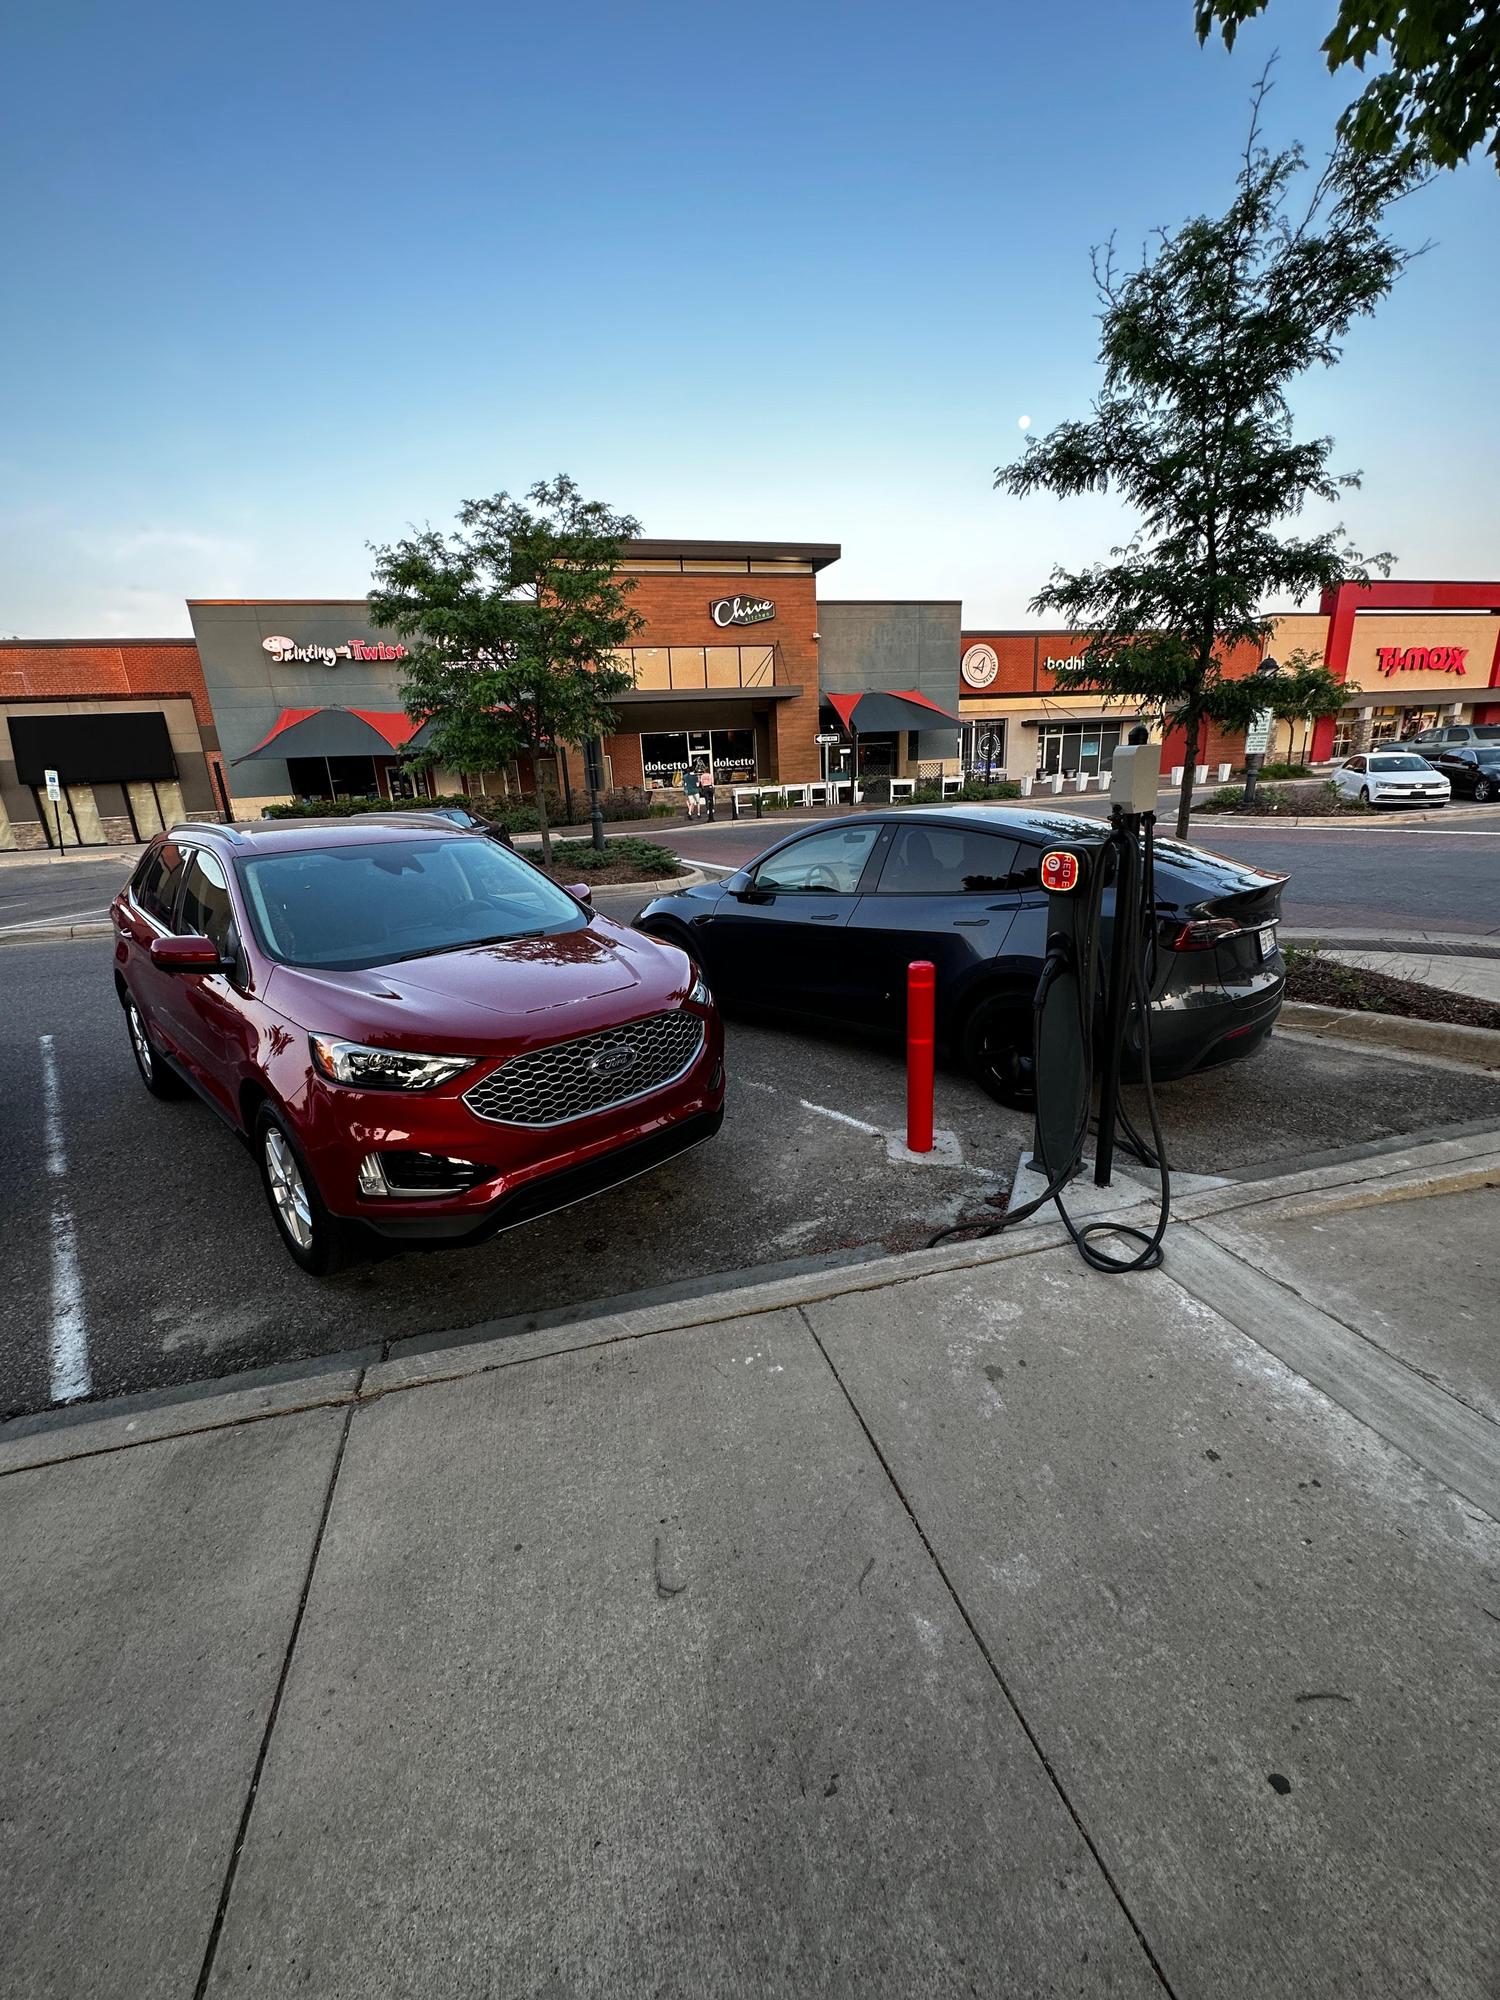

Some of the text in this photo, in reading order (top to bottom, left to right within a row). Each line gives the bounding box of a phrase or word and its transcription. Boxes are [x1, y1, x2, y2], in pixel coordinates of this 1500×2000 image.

[714, 597, 773, 626] Chive
[262, 635, 336, 667] Painting
[348, 639, 405, 661] Twist
[1046, 656, 1085, 670] bodhi
[645, 761, 688, 771] dolcetto
[714, 758, 754, 767] dolcetto
[603, 1054, 627, 1069] Ford
